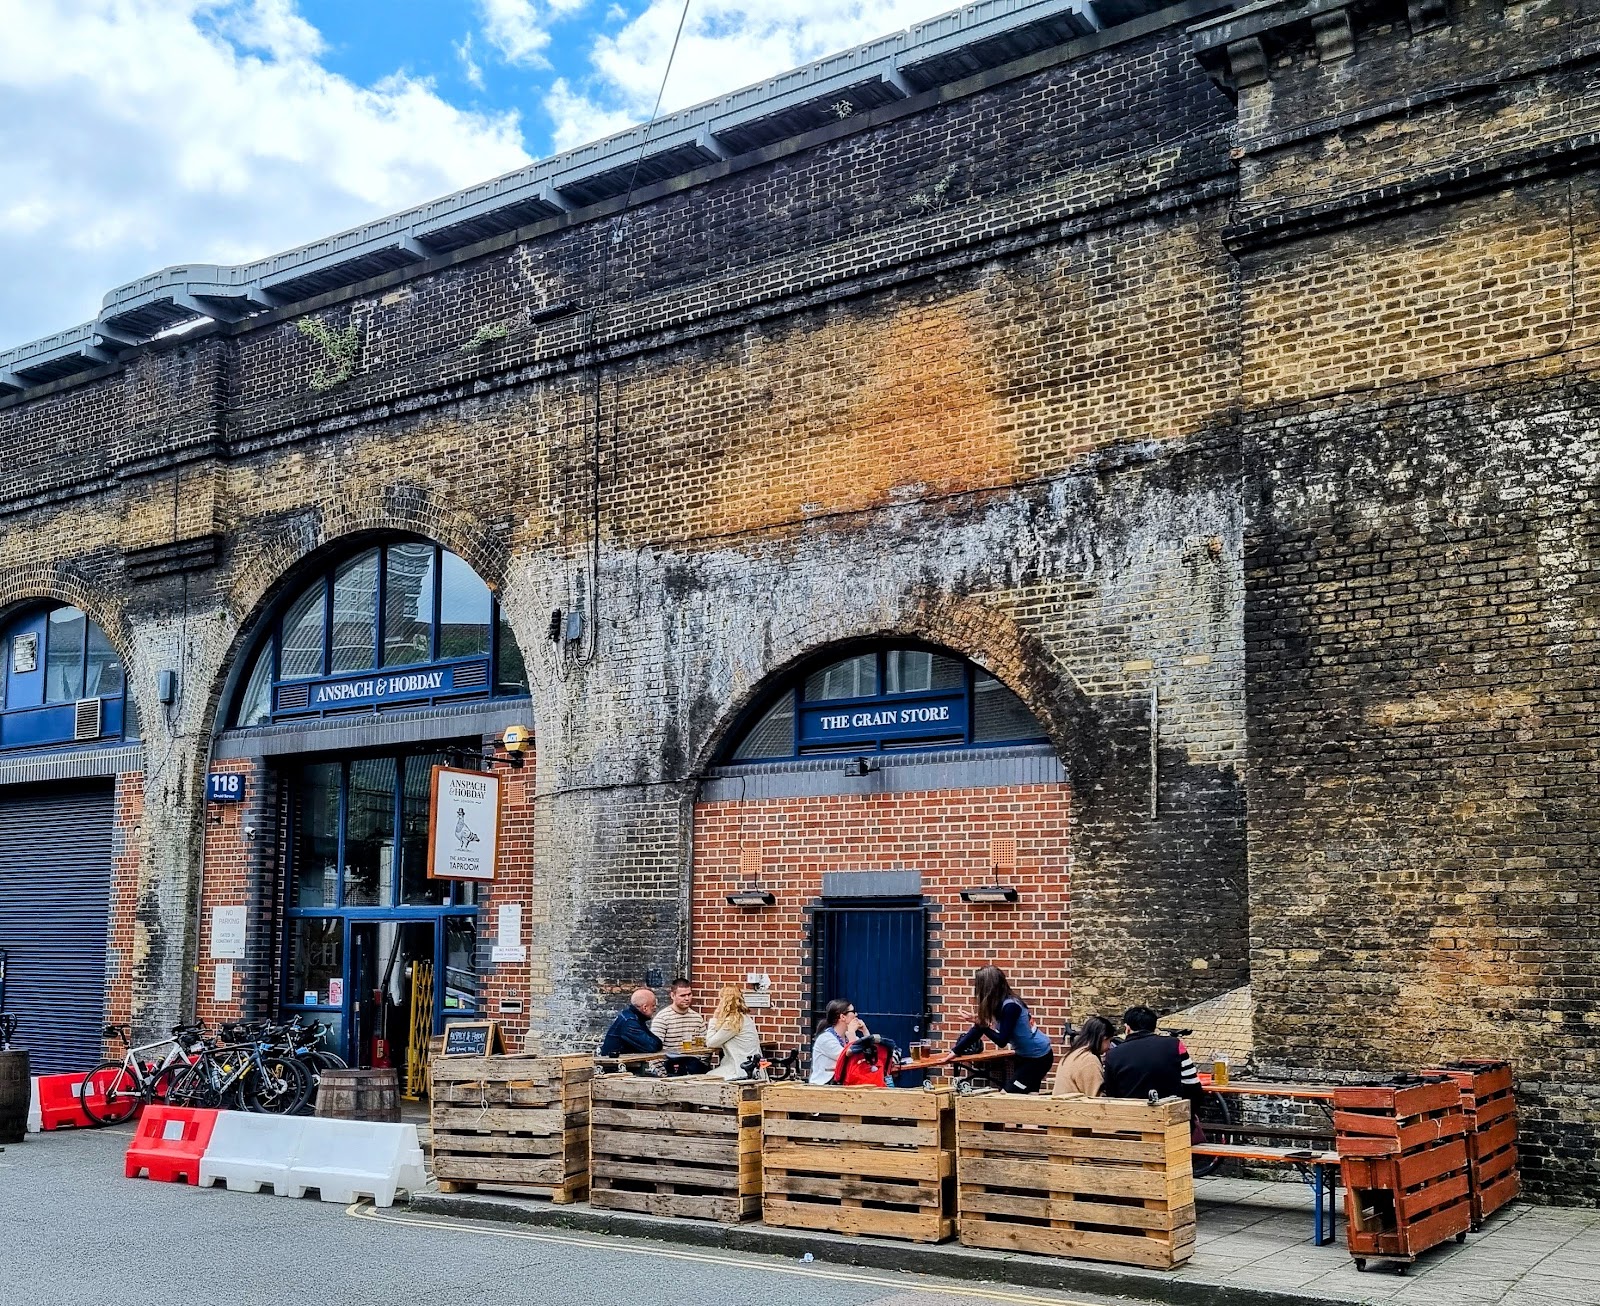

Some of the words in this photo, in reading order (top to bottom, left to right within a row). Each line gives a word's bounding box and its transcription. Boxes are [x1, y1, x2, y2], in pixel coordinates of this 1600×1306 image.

[317, 681, 374, 702] ANSPACH
[376, 678, 387, 696] &
[388, 672, 443, 693] HOBDAY
[821, 715, 849, 730] THE
[852, 711, 897, 727] GRAIN
[901, 706, 949, 723] STORE
[211, 775, 239, 792] 118
[449, 779, 486, 791] ANSPACH
[450, 862, 479, 871] TAPROOM
